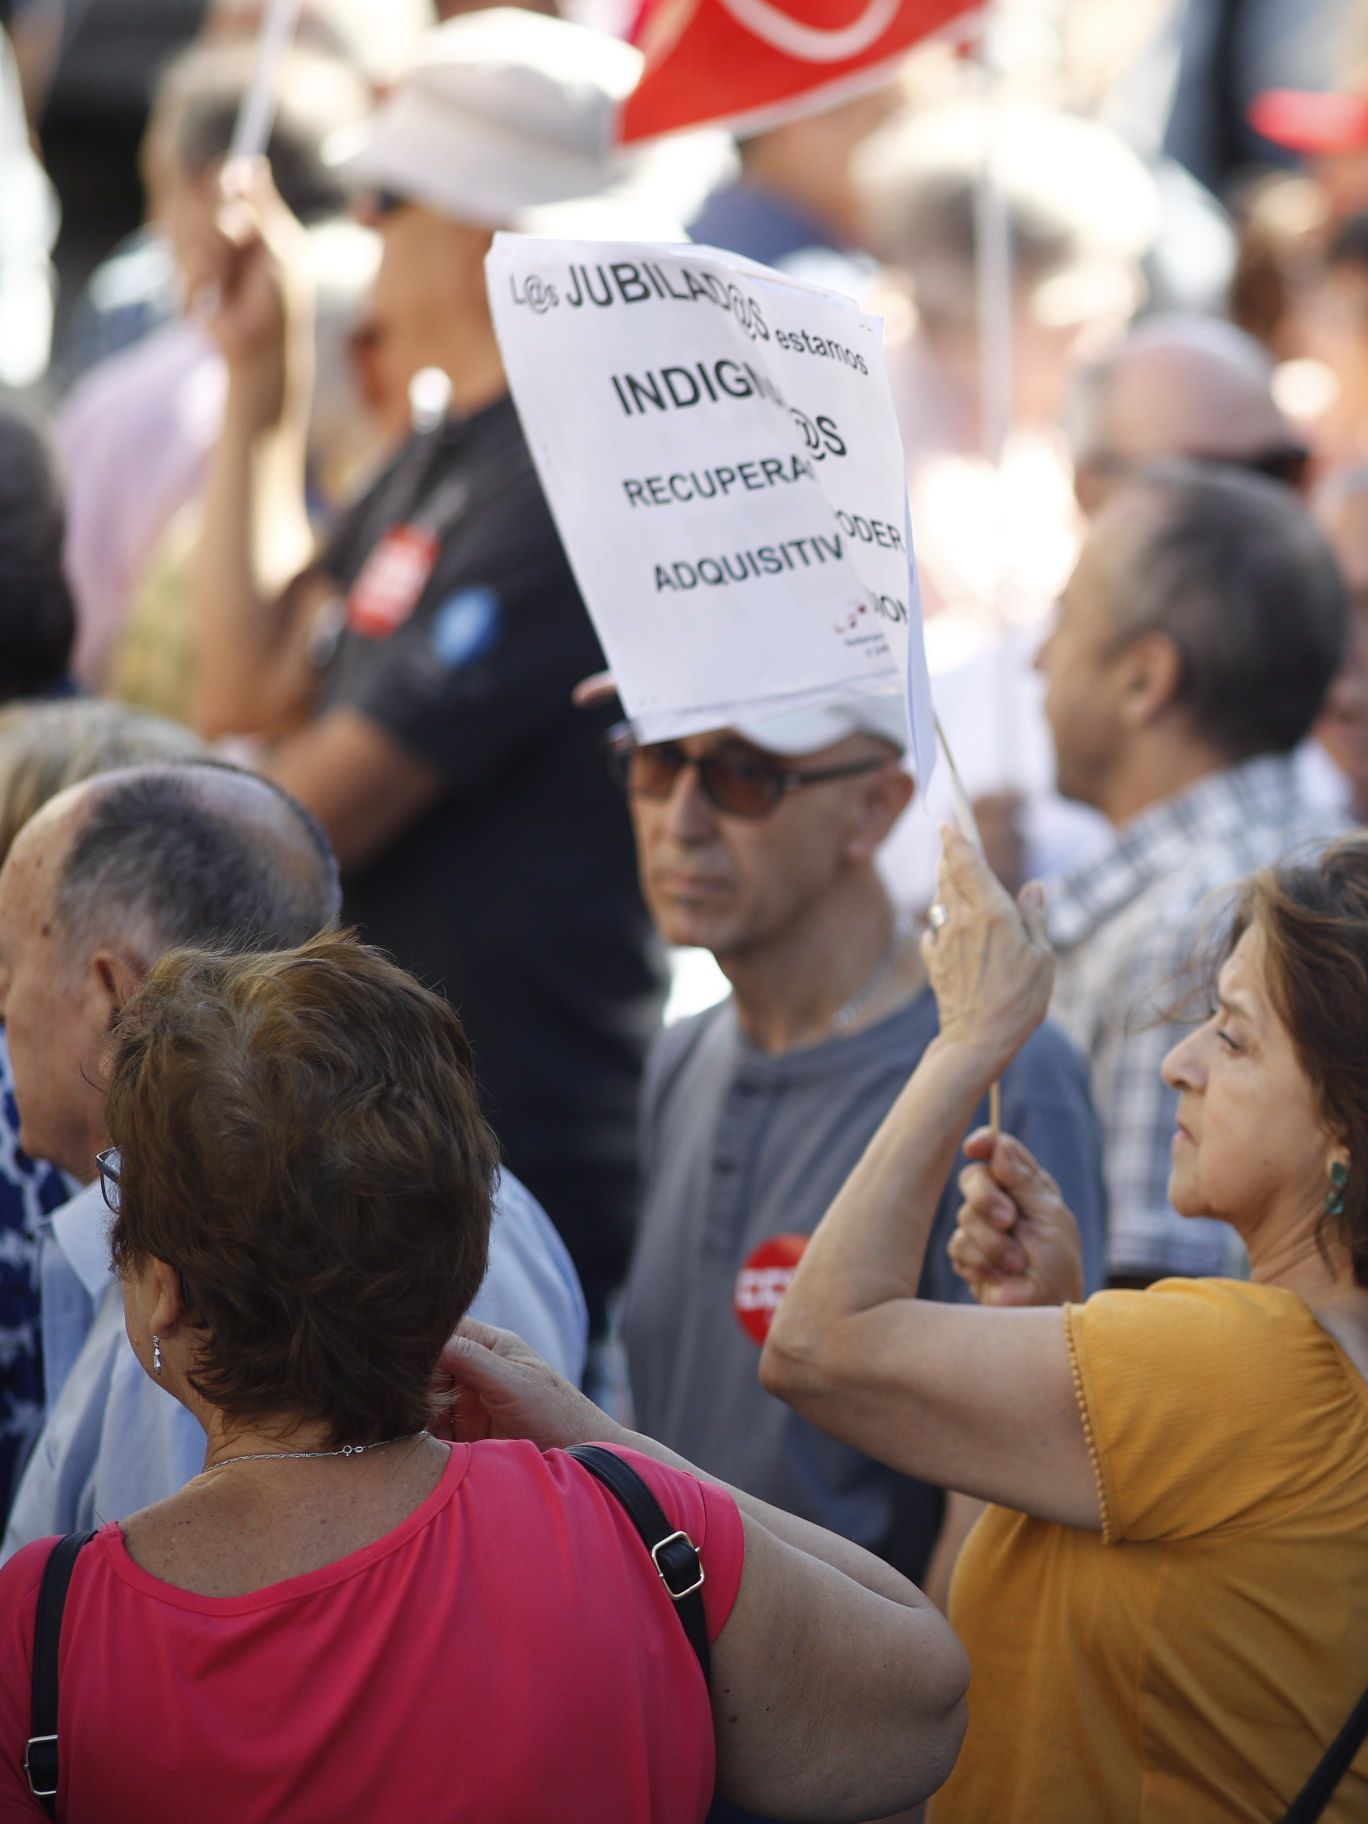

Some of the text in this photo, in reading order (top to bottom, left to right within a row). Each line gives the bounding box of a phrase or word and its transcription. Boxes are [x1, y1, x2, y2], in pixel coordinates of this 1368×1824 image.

[509, 262, 868, 376] L@s JUBILAD@S estamos
[836, 510, 907, 553] ODER
[653, 534, 844, 593] ADQUISITIV
